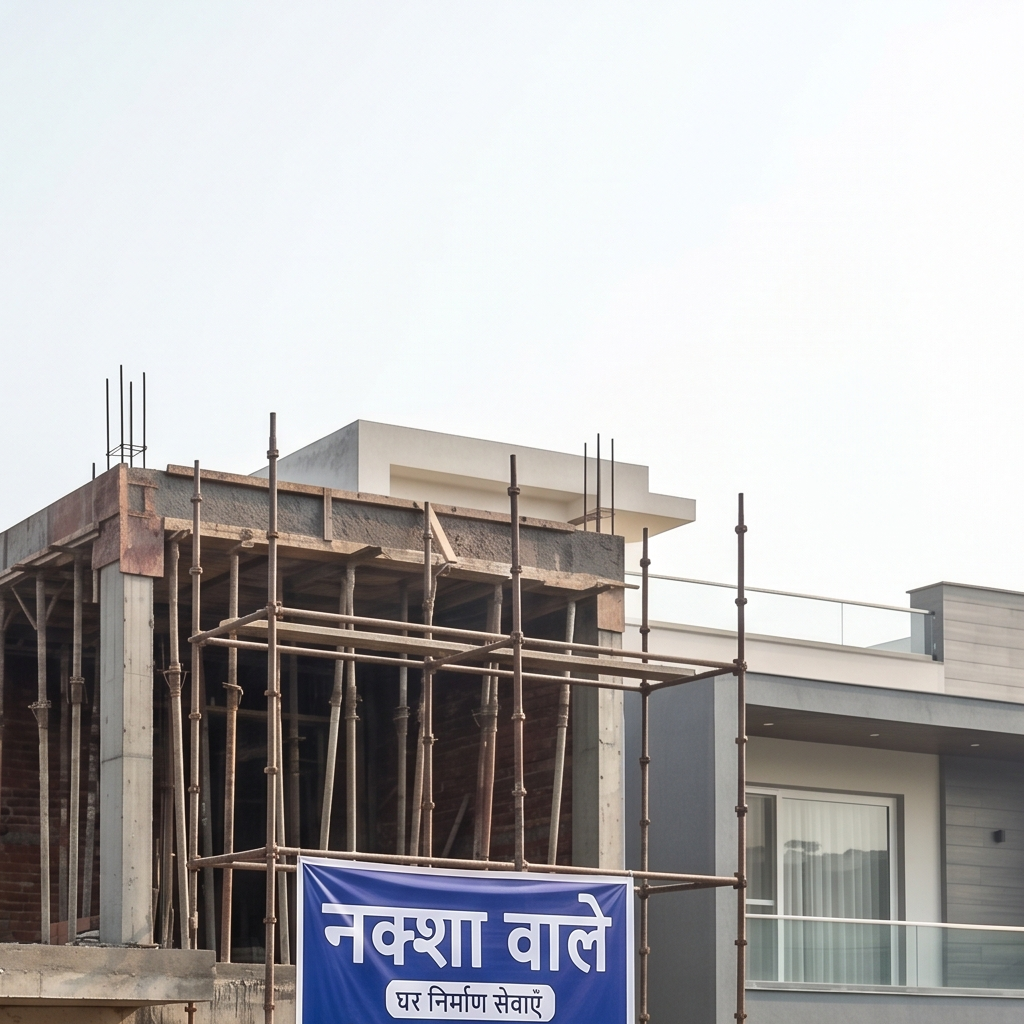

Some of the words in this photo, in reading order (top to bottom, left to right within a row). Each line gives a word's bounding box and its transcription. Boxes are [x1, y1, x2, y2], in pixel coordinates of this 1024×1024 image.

[321, 903, 488, 969] नक्शा
[503, 893, 613, 973] वाले
[395, 991, 422, 1012] घर
[427, 985, 488, 1013] निर्माण
